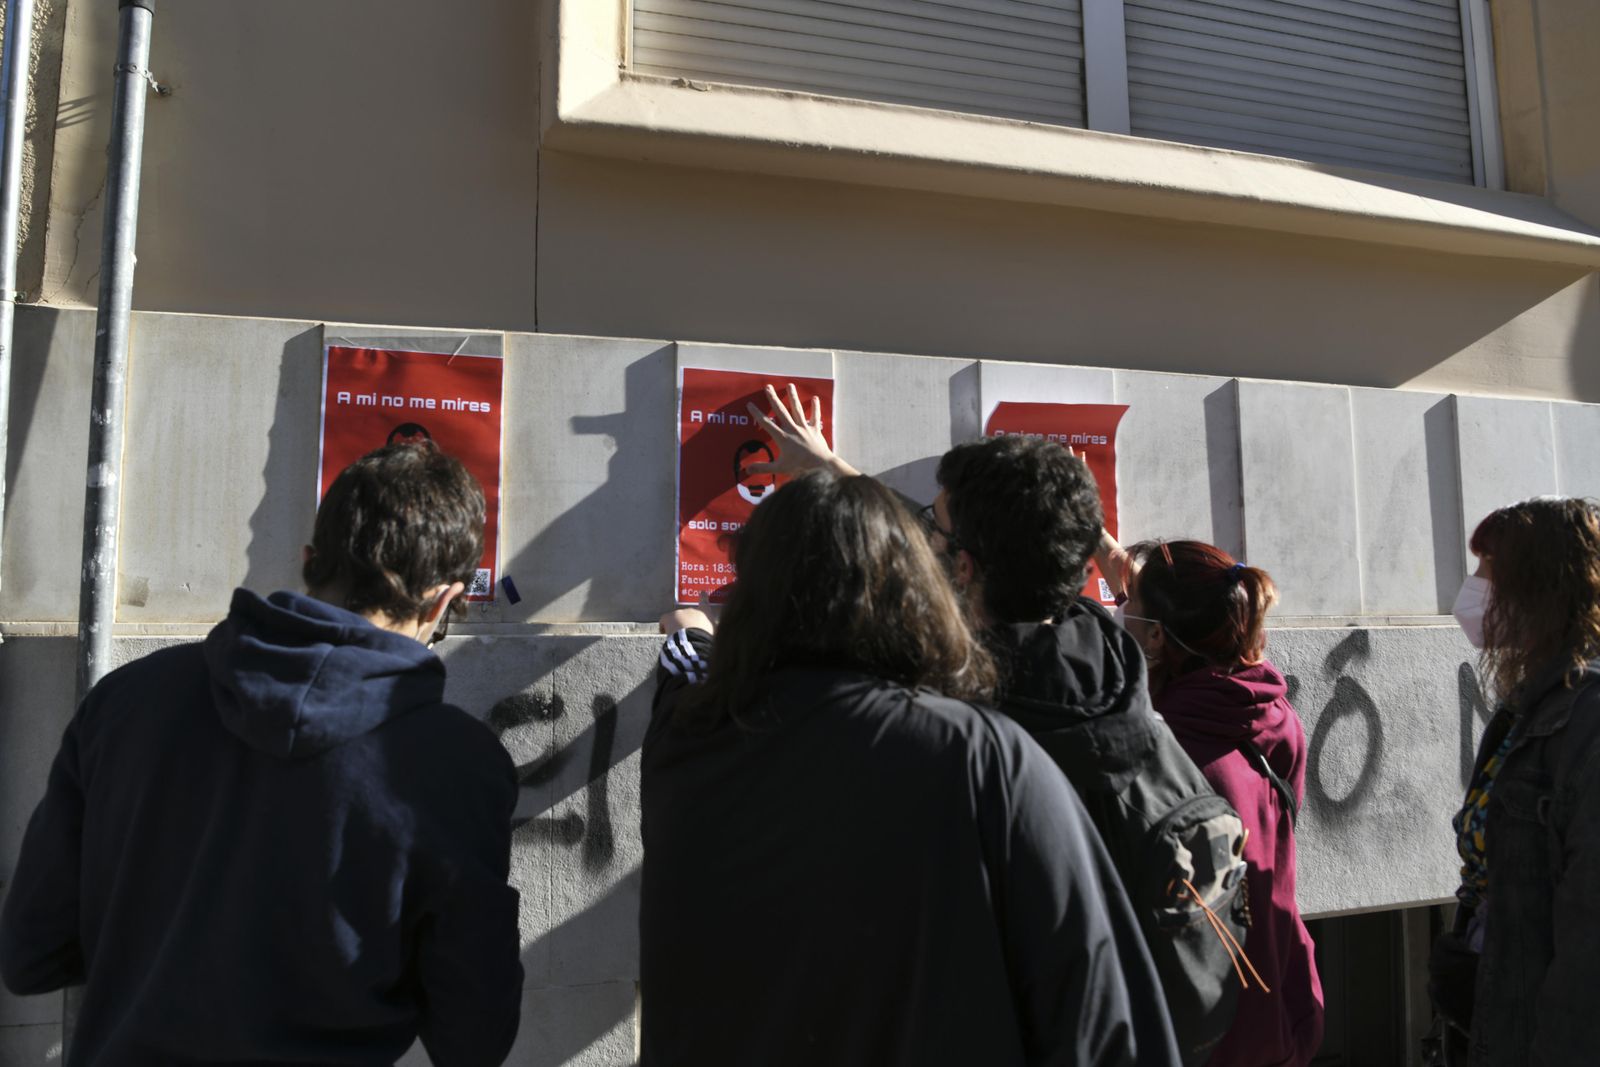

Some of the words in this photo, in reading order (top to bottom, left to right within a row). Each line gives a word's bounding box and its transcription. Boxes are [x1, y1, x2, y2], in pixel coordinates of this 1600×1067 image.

[337, 391, 351, 404] A
[356, 392, 377, 406] mi
[381, 395, 404, 407] no
[409, 396, 436, 409] me
[441, 397, 491, 413] mires
[690, 410, 703, 423] A
[707, 411, 725, 424] mi
[729, 414, 748, 425] no
[1071, 432, 1108, 445] mires
[688, 519, 718, 530] solo
[681, 561, 709, 572] Hora:
[681, 575, 728, 586] Facultad
